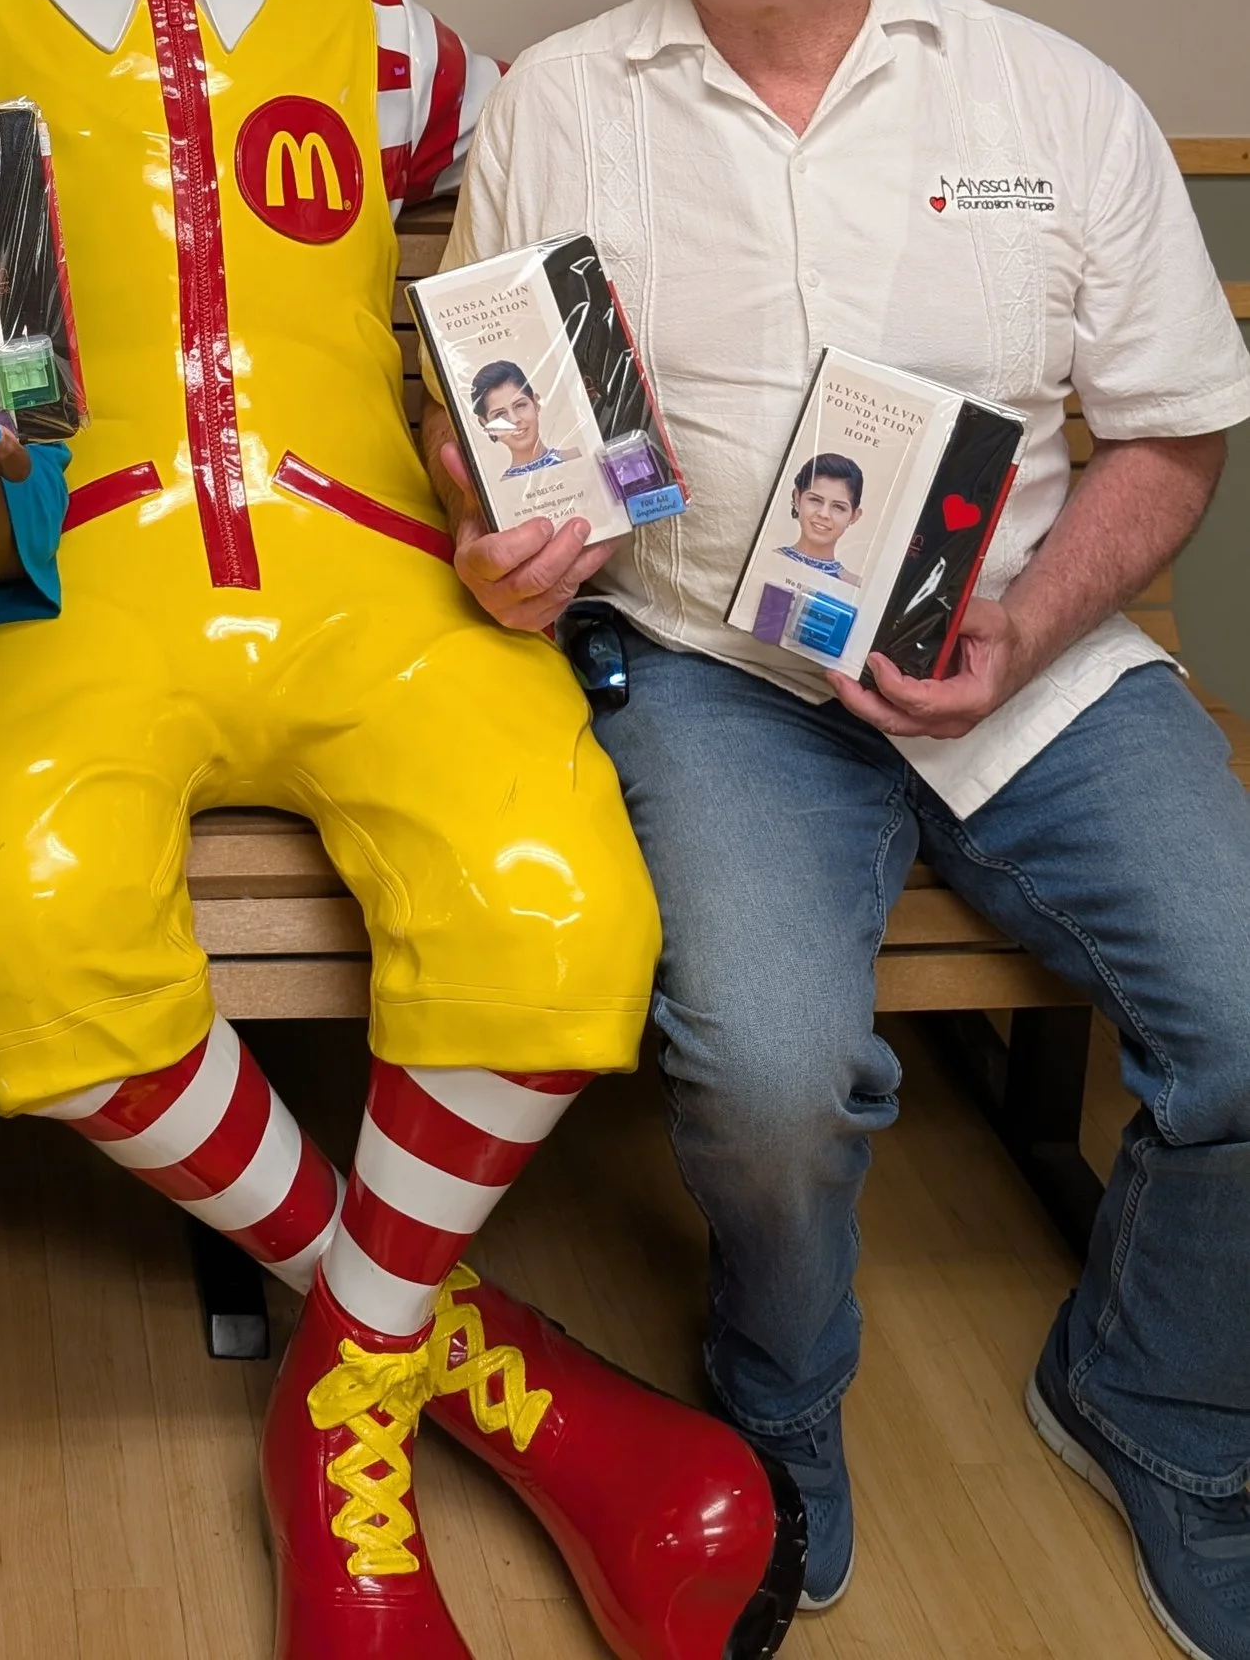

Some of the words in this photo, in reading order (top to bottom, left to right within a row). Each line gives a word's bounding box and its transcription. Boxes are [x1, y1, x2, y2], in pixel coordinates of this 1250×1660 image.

[956, 176, 1011, 196] Alyssa
[1013, 175, 1054, 196] Alvin
[1028, 200, 1055, 212] Hope
[437, 299, 486, 320] ALYSSA
[490, 284, 529, 304] ALVIN
[445, 298, 530, 331] FOUNDATION
[481, 320, 501, 330] FOR
[477, 327, 512, 346] HOPE
[825, 381, 877, 407] ALYSSA
[881, 403, 926, 425] ALVIN
[826, 394, 916, 436] FOUNDATION
[844, 426, 881, 448] HOPE
[855, 420, 877, 433] FOR
[536, 482, 565, 496] BELIEVE
[521, 507, 533, 515] the
[532, 500, 557, 510] healing
[556, 494, 576, 505] power
[577, 490, 584, 498] of
[785, 577, 796, 587] We
